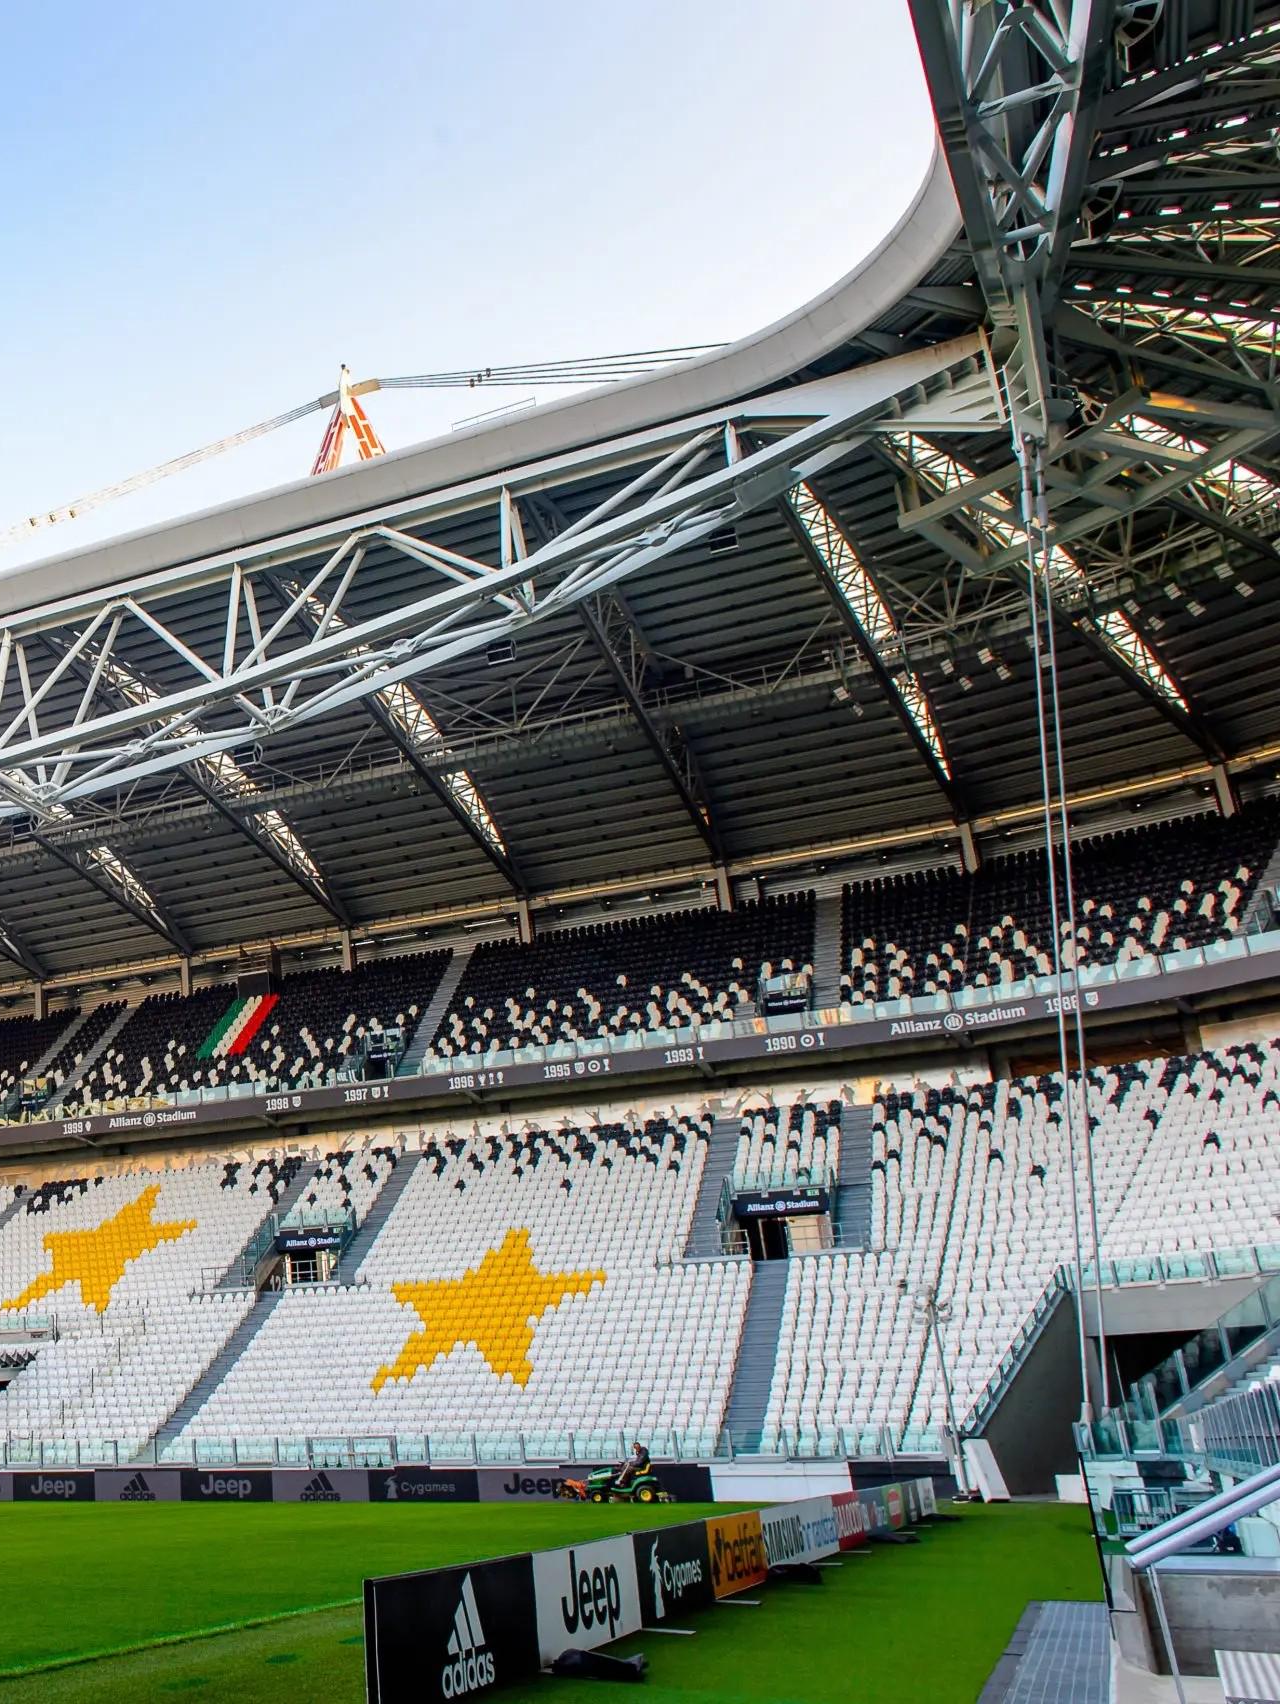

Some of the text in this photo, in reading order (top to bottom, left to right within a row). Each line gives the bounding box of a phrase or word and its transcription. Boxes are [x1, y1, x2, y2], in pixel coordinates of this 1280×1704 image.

[890, 1004, 1026, 1036] Allianz Stadium
[765, 1035, 797, 1052] 1990
[664, 1048, 694, 1064] 1993
[543, 1063, 571, 1078] 1995
[448, 1075, 475, 1090] 1996
[344, 1088, 368, 1102] 1997
[109, 1109, 197, 1129] Allianz Stadium
[747, 1200, 820, 1212] Allianz Stadium
[286, 1240, 308, 1248] Allianz
[30, 1475, 76, 1498] Jeep
[200, 1474, 252, 1498] Jeep
[400, 1481, 456, 1495] Cygames
[761, 1514, 805, 1566] SAMSUNG
[663, 1558, 702, 1600] Cygames
[561, 1550, 621, 1638] Jeep
[442, 1649, 496, 1699] adidas
